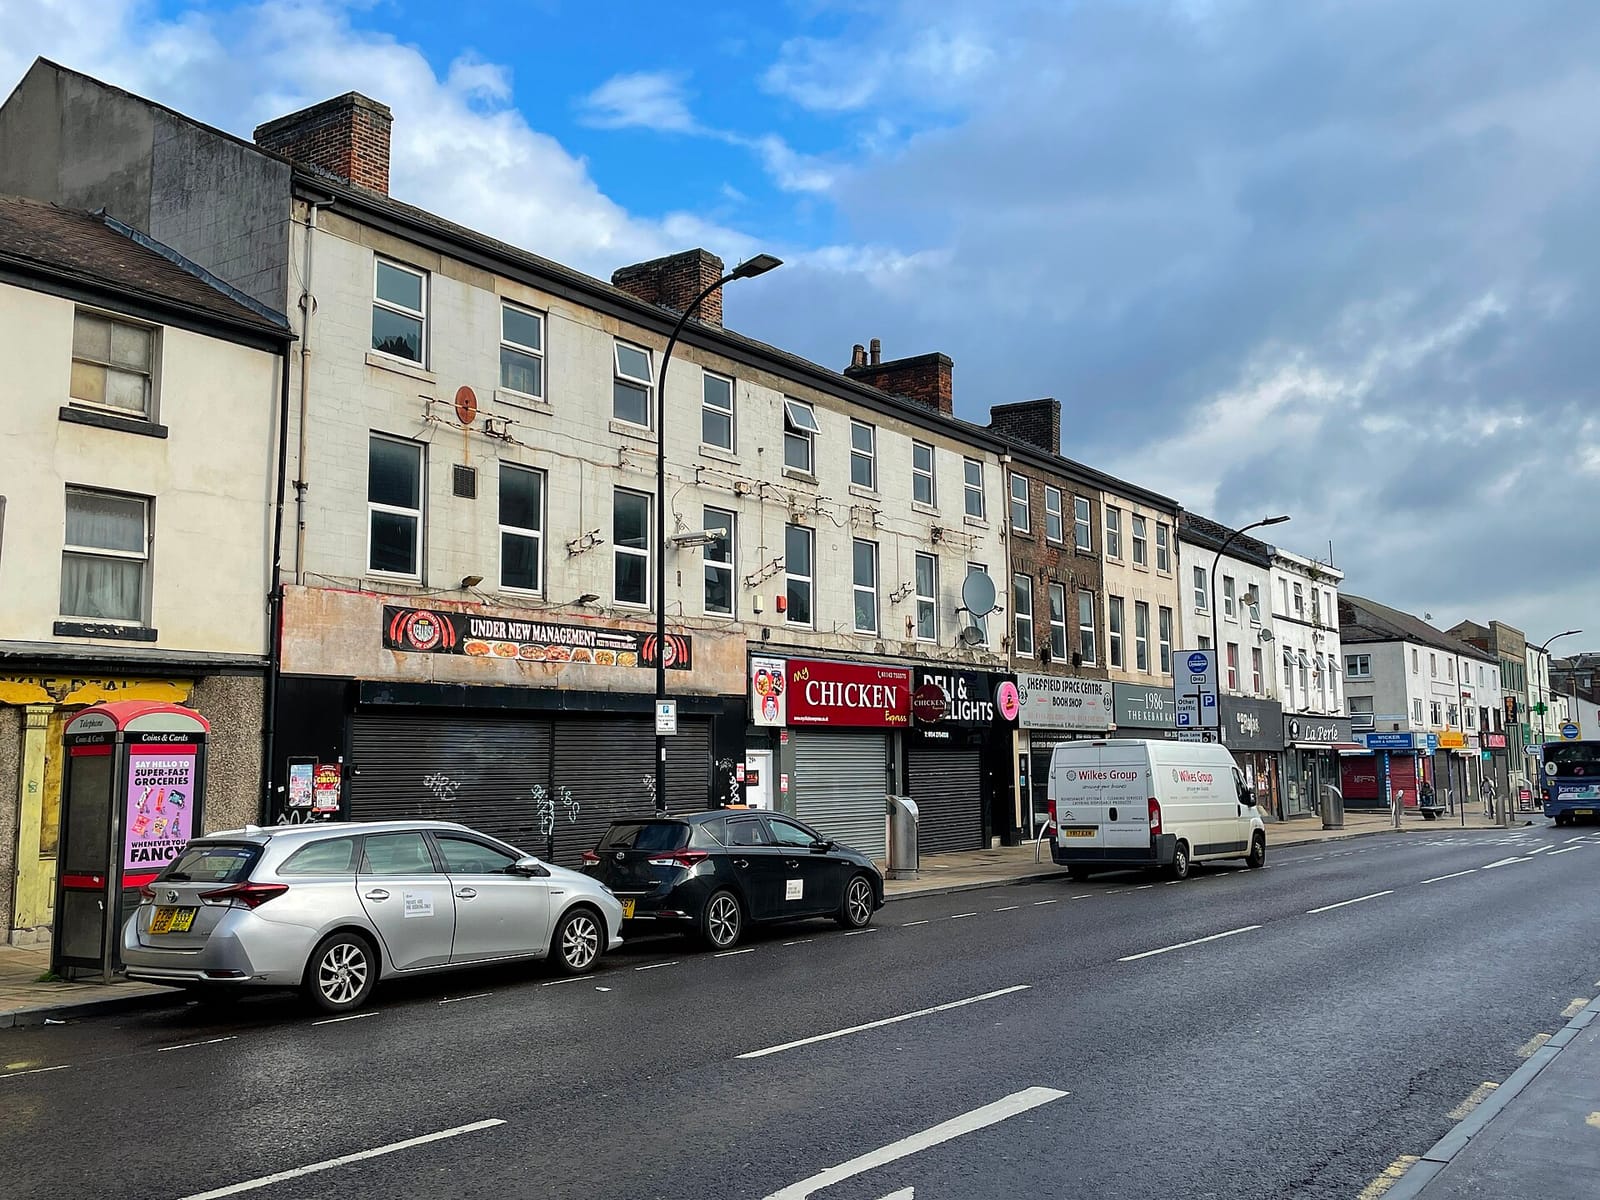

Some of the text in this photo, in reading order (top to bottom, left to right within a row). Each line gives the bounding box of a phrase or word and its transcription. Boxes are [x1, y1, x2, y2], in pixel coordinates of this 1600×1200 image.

[470, 619, 597, 647] UNDER NEW MANAGEMENT
[793, 667, 810, 683] My
[957, 677, 968, 700] &
[1027, 677, 1102, 695] SHEFFIELD SPACE CENTRE
[805, 680, 897, 709] CHICKEN
[1145, 692, 1163, 709] 1986
[1205, 696, 1212, 705] P
[1052, 696, 1082, 707] BOOK SHOP
[1128, 710, 1141, 720] THE
[1143, 711, 1162, 721] KEBAB
[1180, 714, 1187, 724] P
[80, 719, 104, 729] Telephone
[142, 733, 160, 742] Coins
[168, 733, 188, 742] Cards
[1304, 723, 1338, 741] La Perle
[152, 760, 177, 768] HELLO
[135, 768, 189, 776] SUPER-FAST
[1078, 769, 1137, 782] Wilkes Group
[1179, 770, 1213, 785] Wilkes Group
[134, 777, 188, 785] GROCERIES
[131, 840, 171, 848] WHENEVER
[130, 846, 186, 862] FANCY
